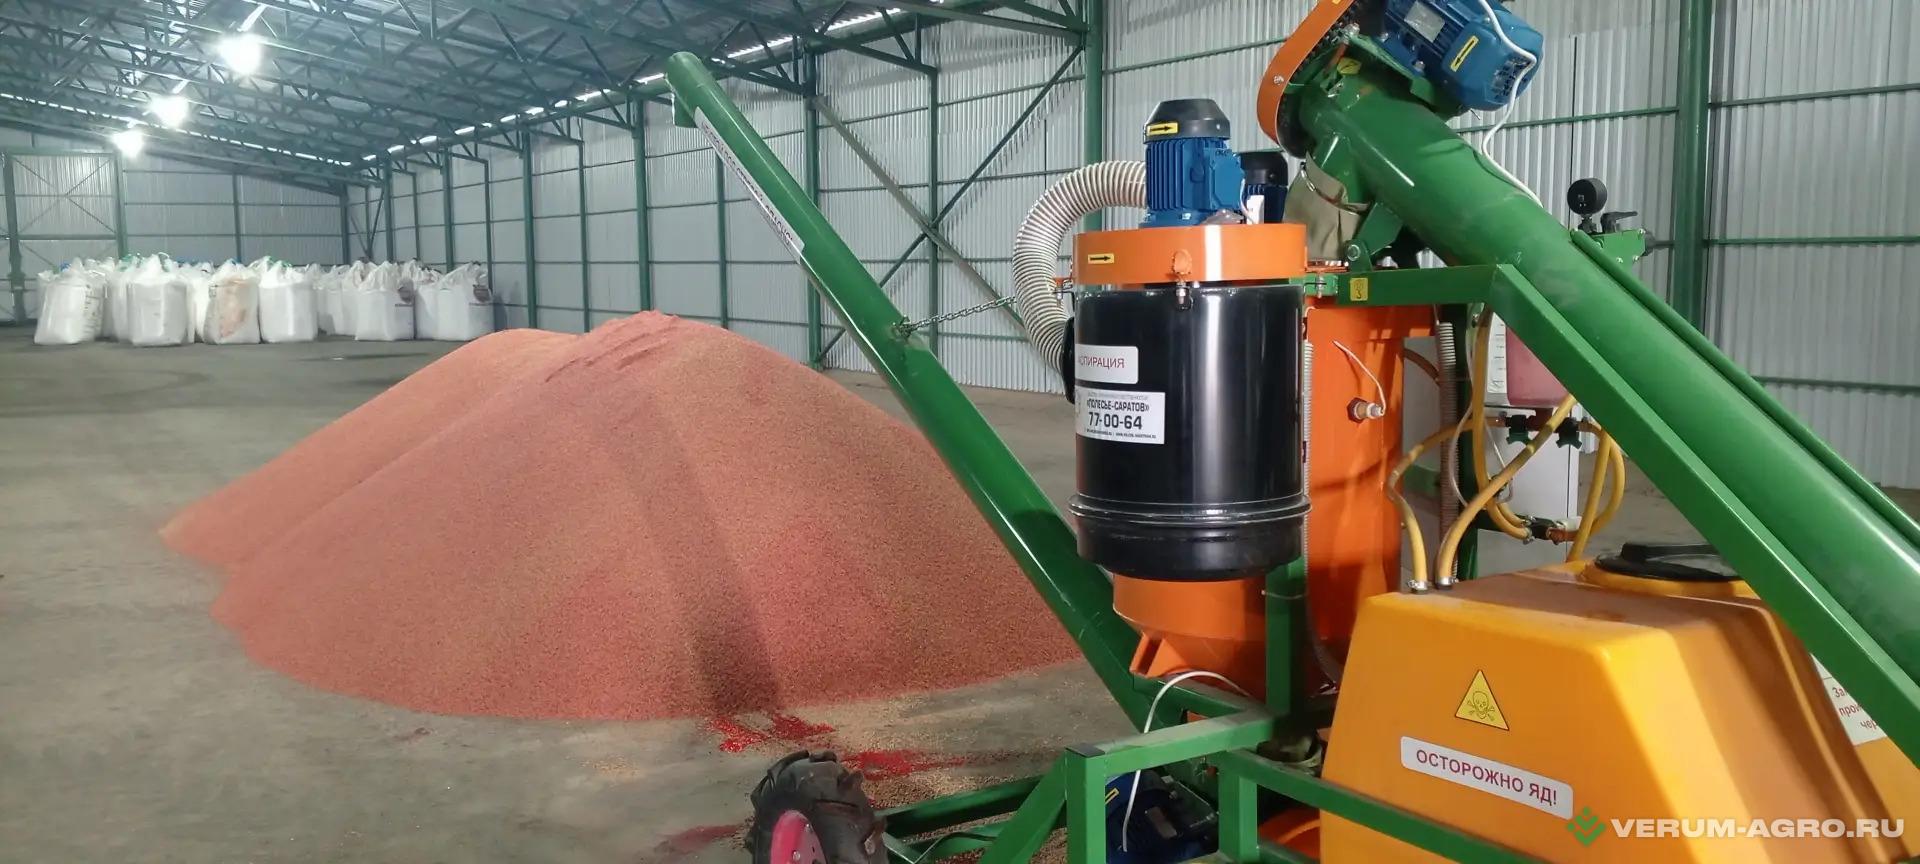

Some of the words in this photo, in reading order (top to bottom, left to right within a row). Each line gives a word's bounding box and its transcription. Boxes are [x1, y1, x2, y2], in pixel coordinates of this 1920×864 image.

[1079, 355, 1125, 370] СПИРАЦИЯ
[1088, 412, 1143, 430] 77-00-64
[1832, 687, 1848, 698] За
[1416, 749, 1524, 793] ОСТОРОЖНО
[1529, 783, 1557, 806] ЯД!
